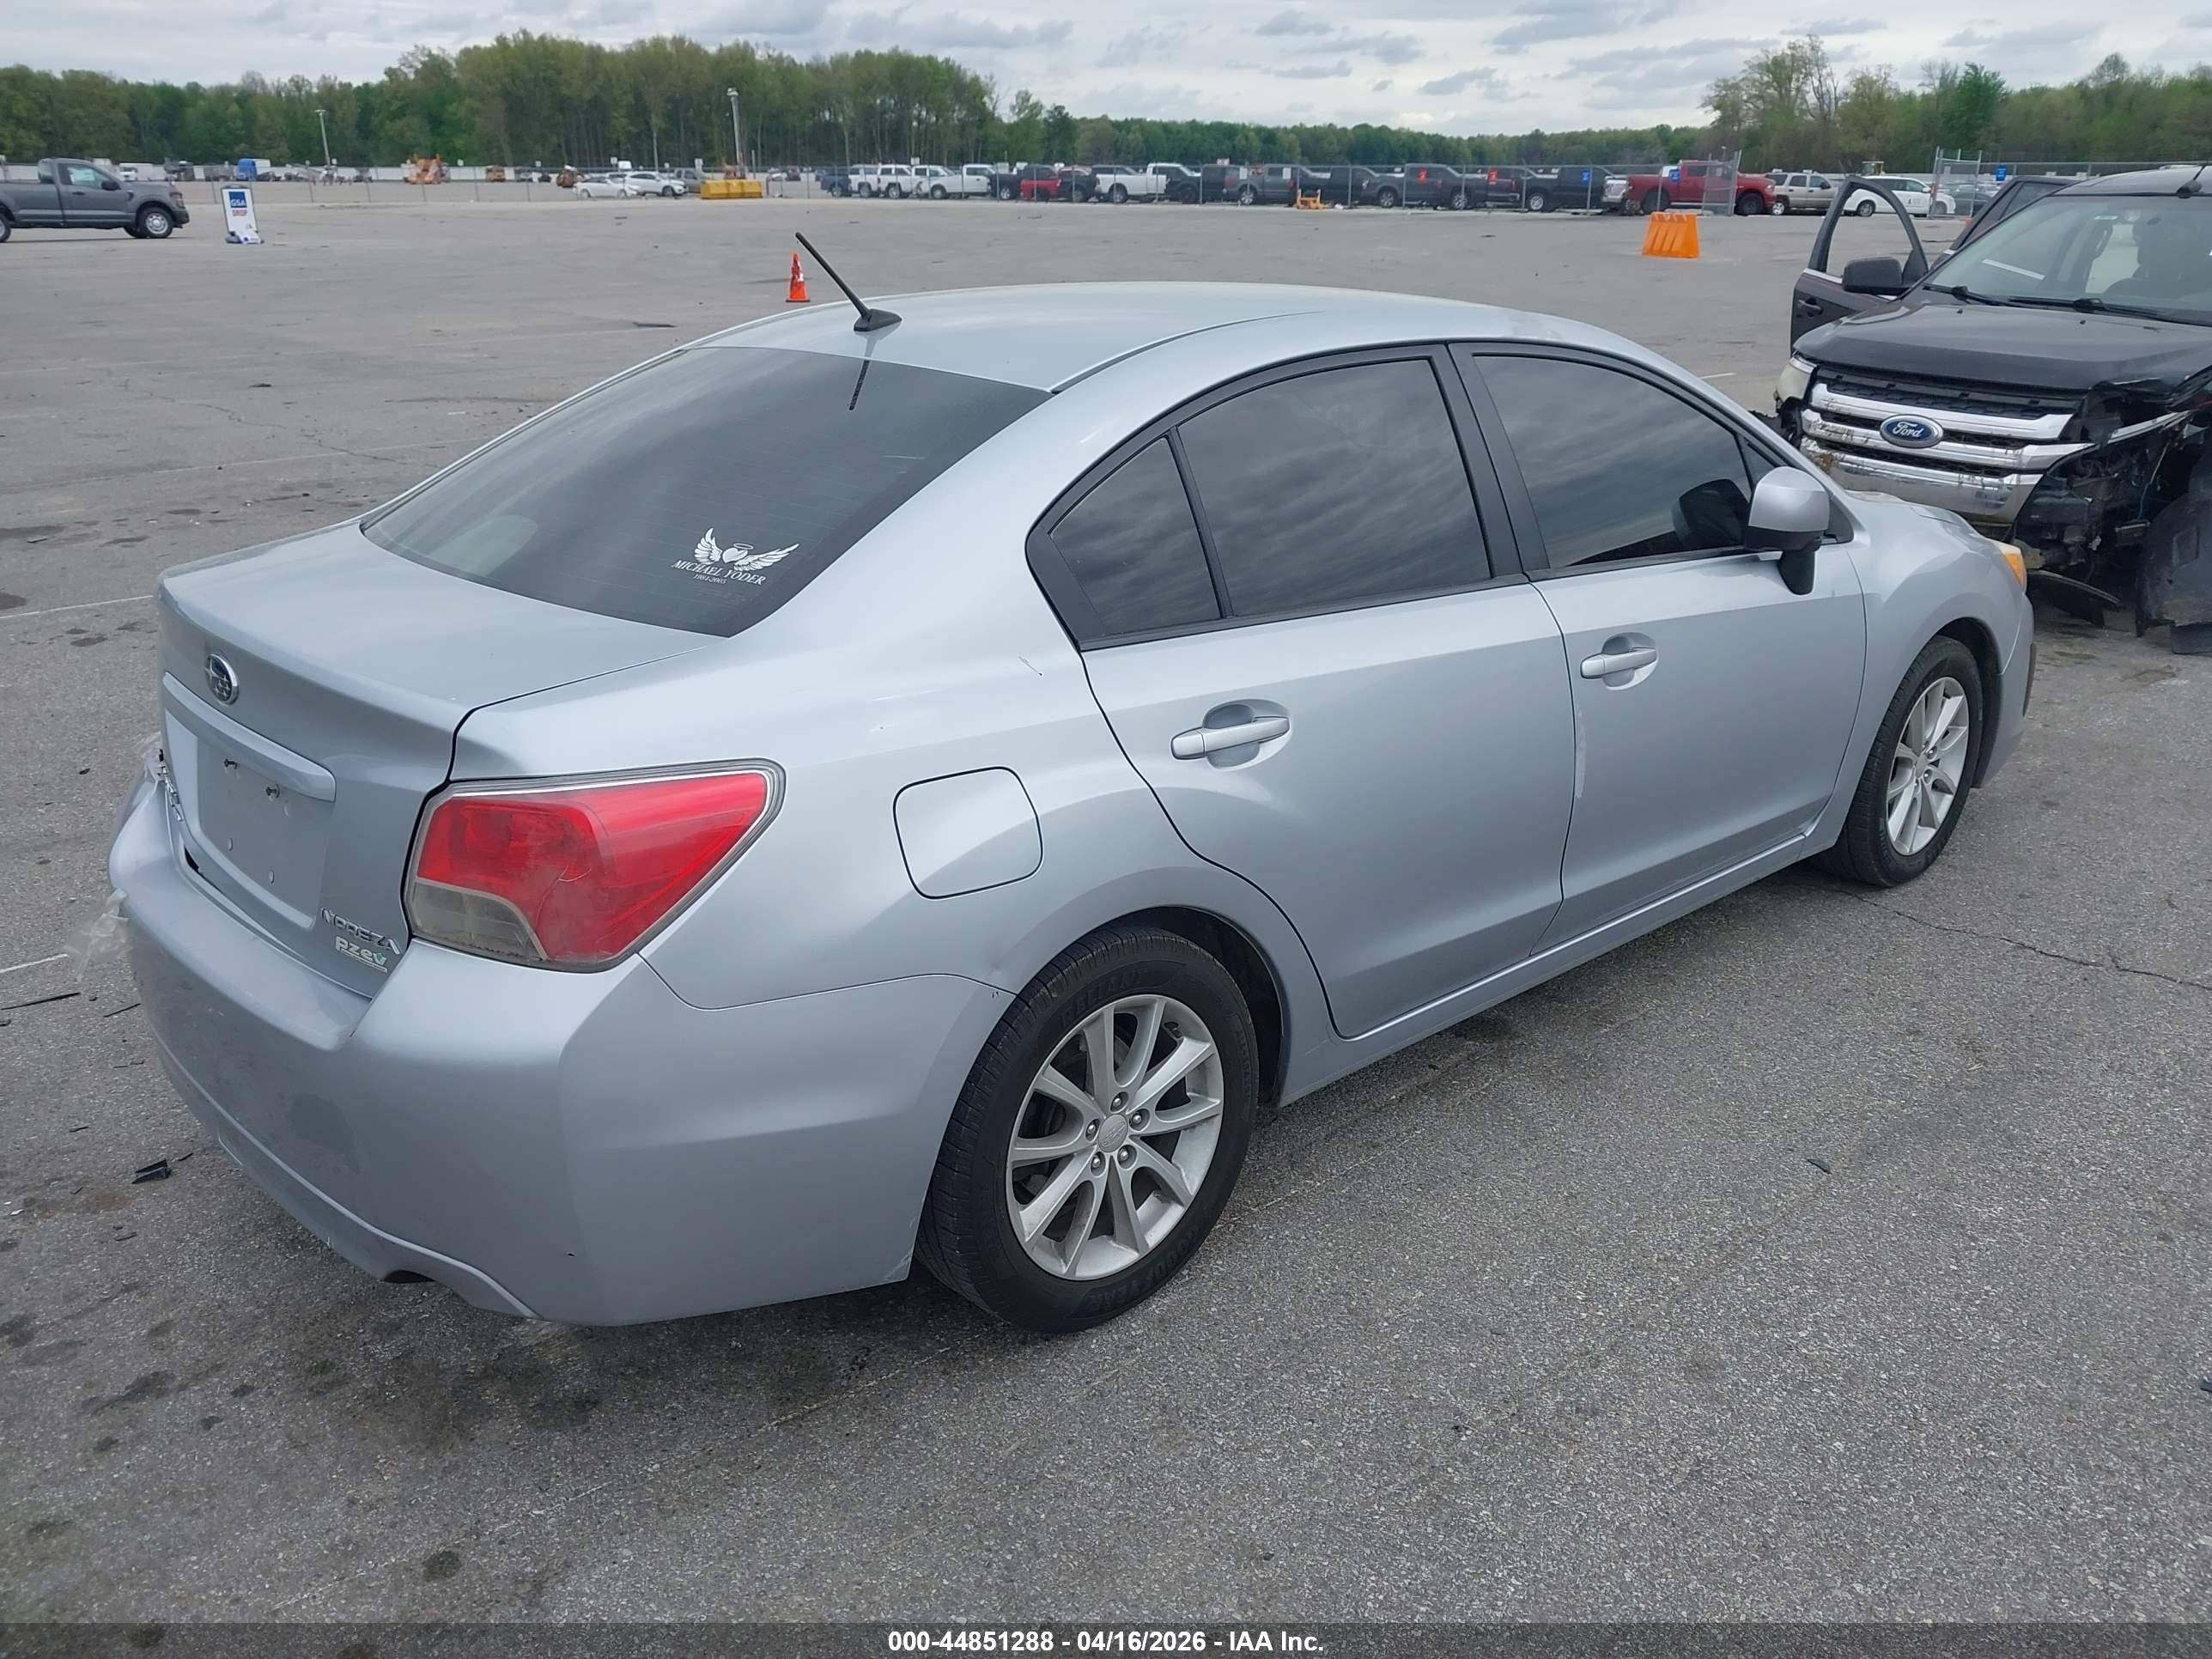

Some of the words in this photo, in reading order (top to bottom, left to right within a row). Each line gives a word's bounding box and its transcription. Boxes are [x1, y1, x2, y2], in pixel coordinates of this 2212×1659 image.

[230, 198, 246, 207] GSA
[1892, 421, 1924, 438] Ford
[671, 559, 725, 577] MICHAEL
[723, 568, 767, 586] YODER
